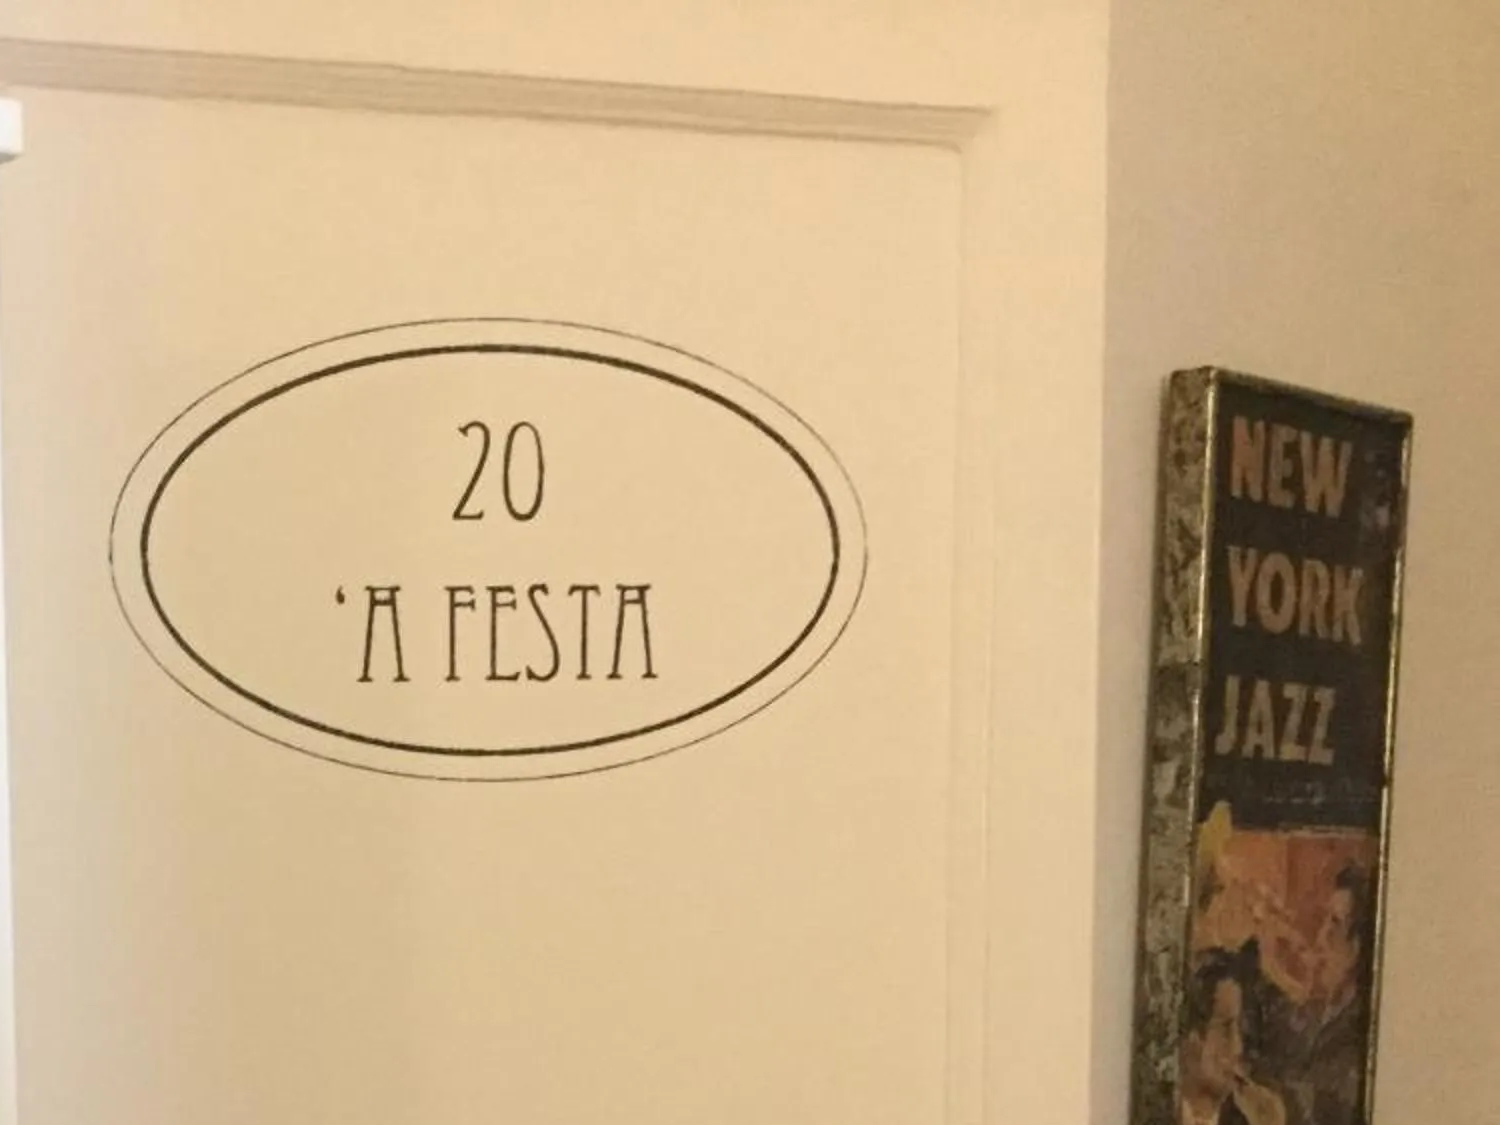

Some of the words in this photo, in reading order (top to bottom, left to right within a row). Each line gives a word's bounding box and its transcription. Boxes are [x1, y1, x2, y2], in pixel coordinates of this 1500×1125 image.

[451, 420, 545, 522] 20
[1230, 414, 1353, 518] NEW
[445, 582, 658, 683] FESTA
[1227, 545, 1367, 646] YORK
[1214, 675, 1336, 765] JAZZ
